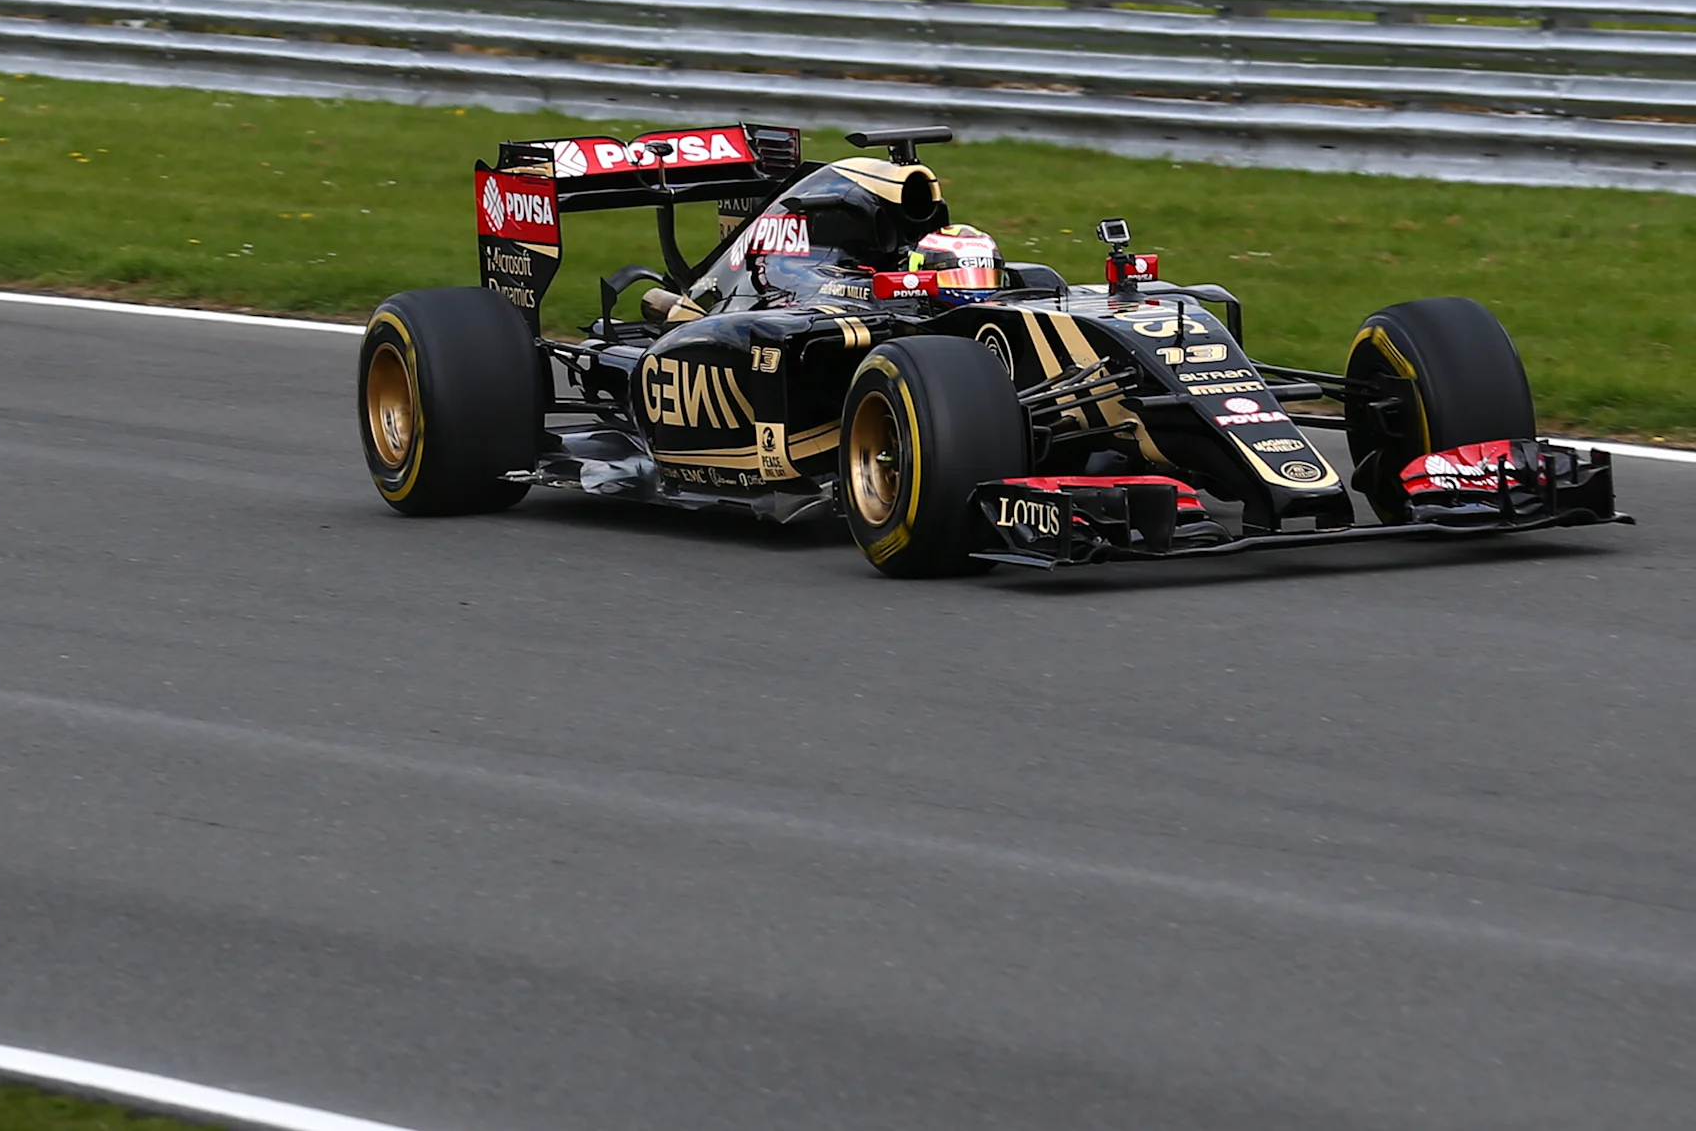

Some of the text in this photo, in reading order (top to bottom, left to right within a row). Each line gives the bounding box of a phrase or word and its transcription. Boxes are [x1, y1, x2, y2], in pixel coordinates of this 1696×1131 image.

[506, 191, 554, 225] PDVSA
[753, 217, 810, 253] PDVSA
[488, 277, 536, 309] Dnamics
[893, 289, 928, 298] PDVSA
[751, 346, 781, 373] 13
[1156, 343, 1228, 365] 13
[642, 354, 755, 429] GENII
[1213, 411, 1291, 427] PDVSA
[996, 497, 1060, 536] LOTUS
